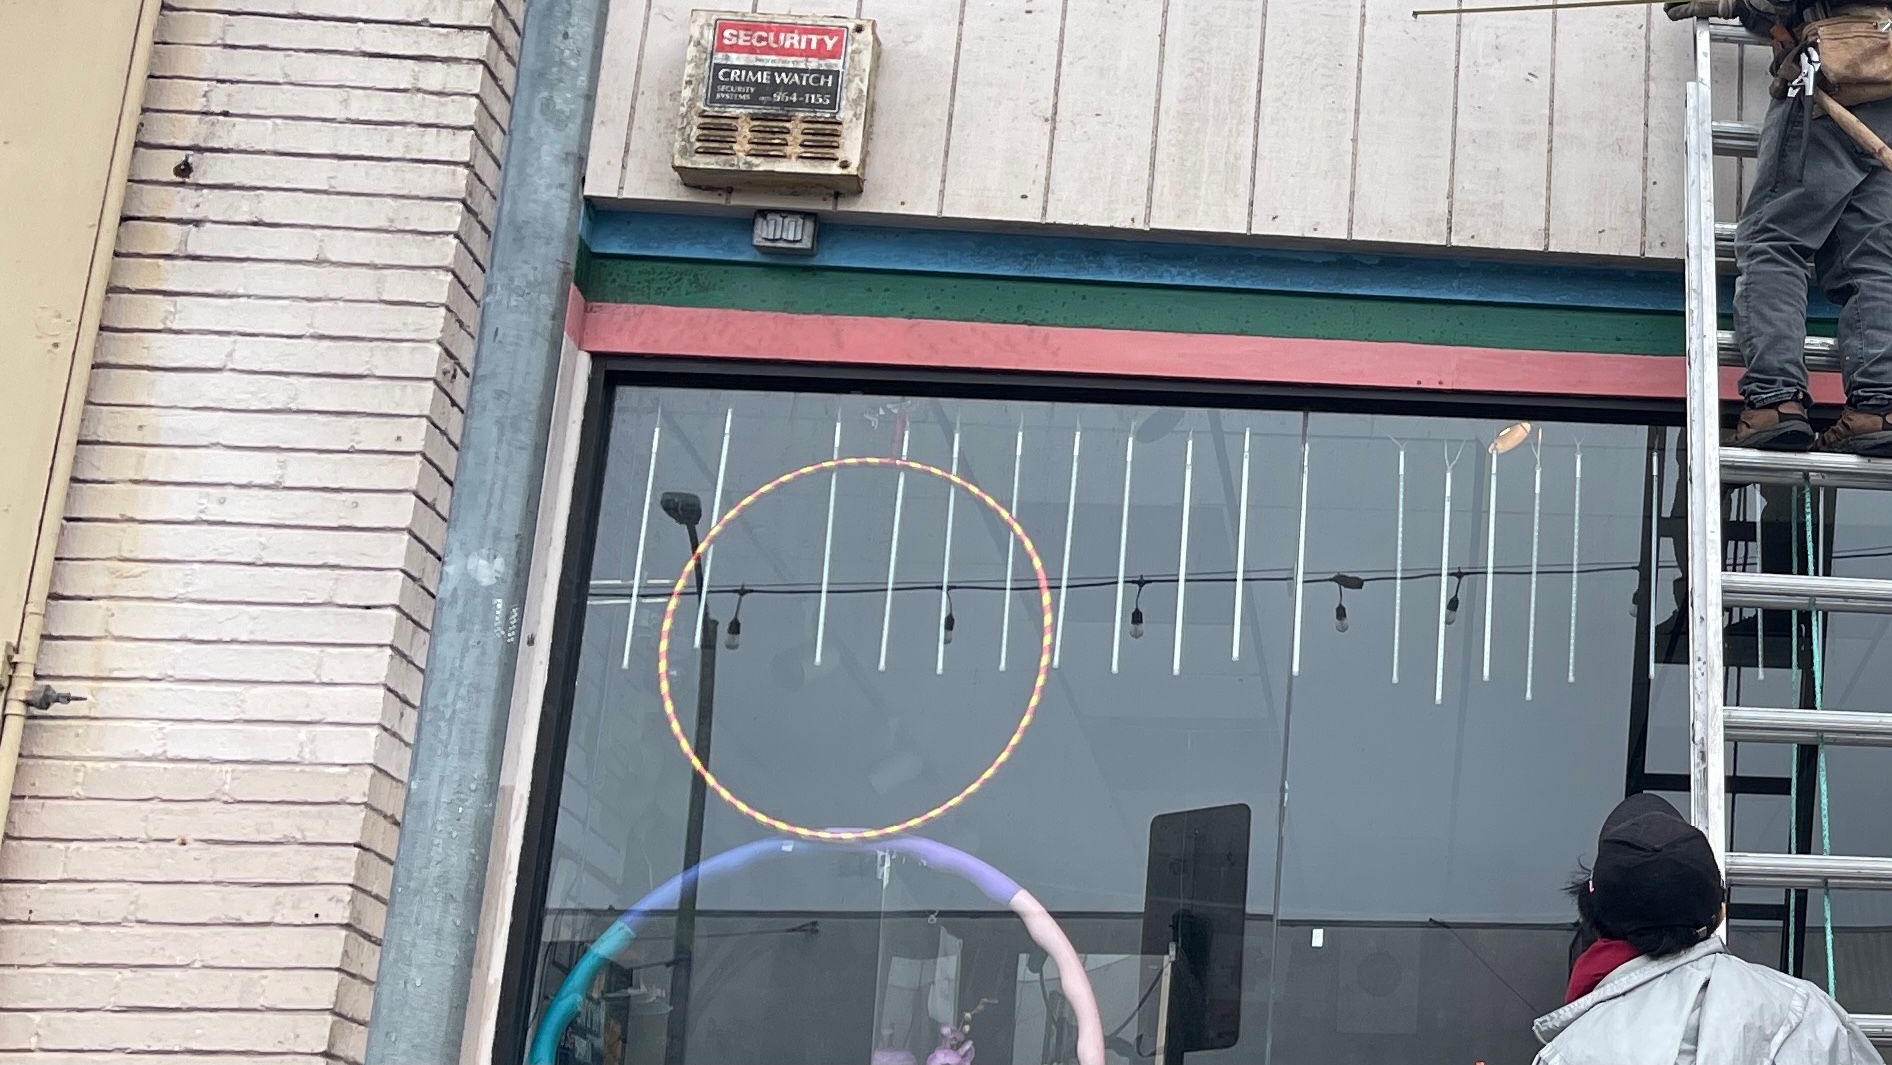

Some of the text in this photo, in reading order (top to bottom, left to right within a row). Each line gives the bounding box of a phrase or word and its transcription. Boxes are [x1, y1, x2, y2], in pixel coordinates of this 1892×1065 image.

[722, 28, 839, 51] SECURITY
[718, 68, 833, 87] CRIME WATCH
